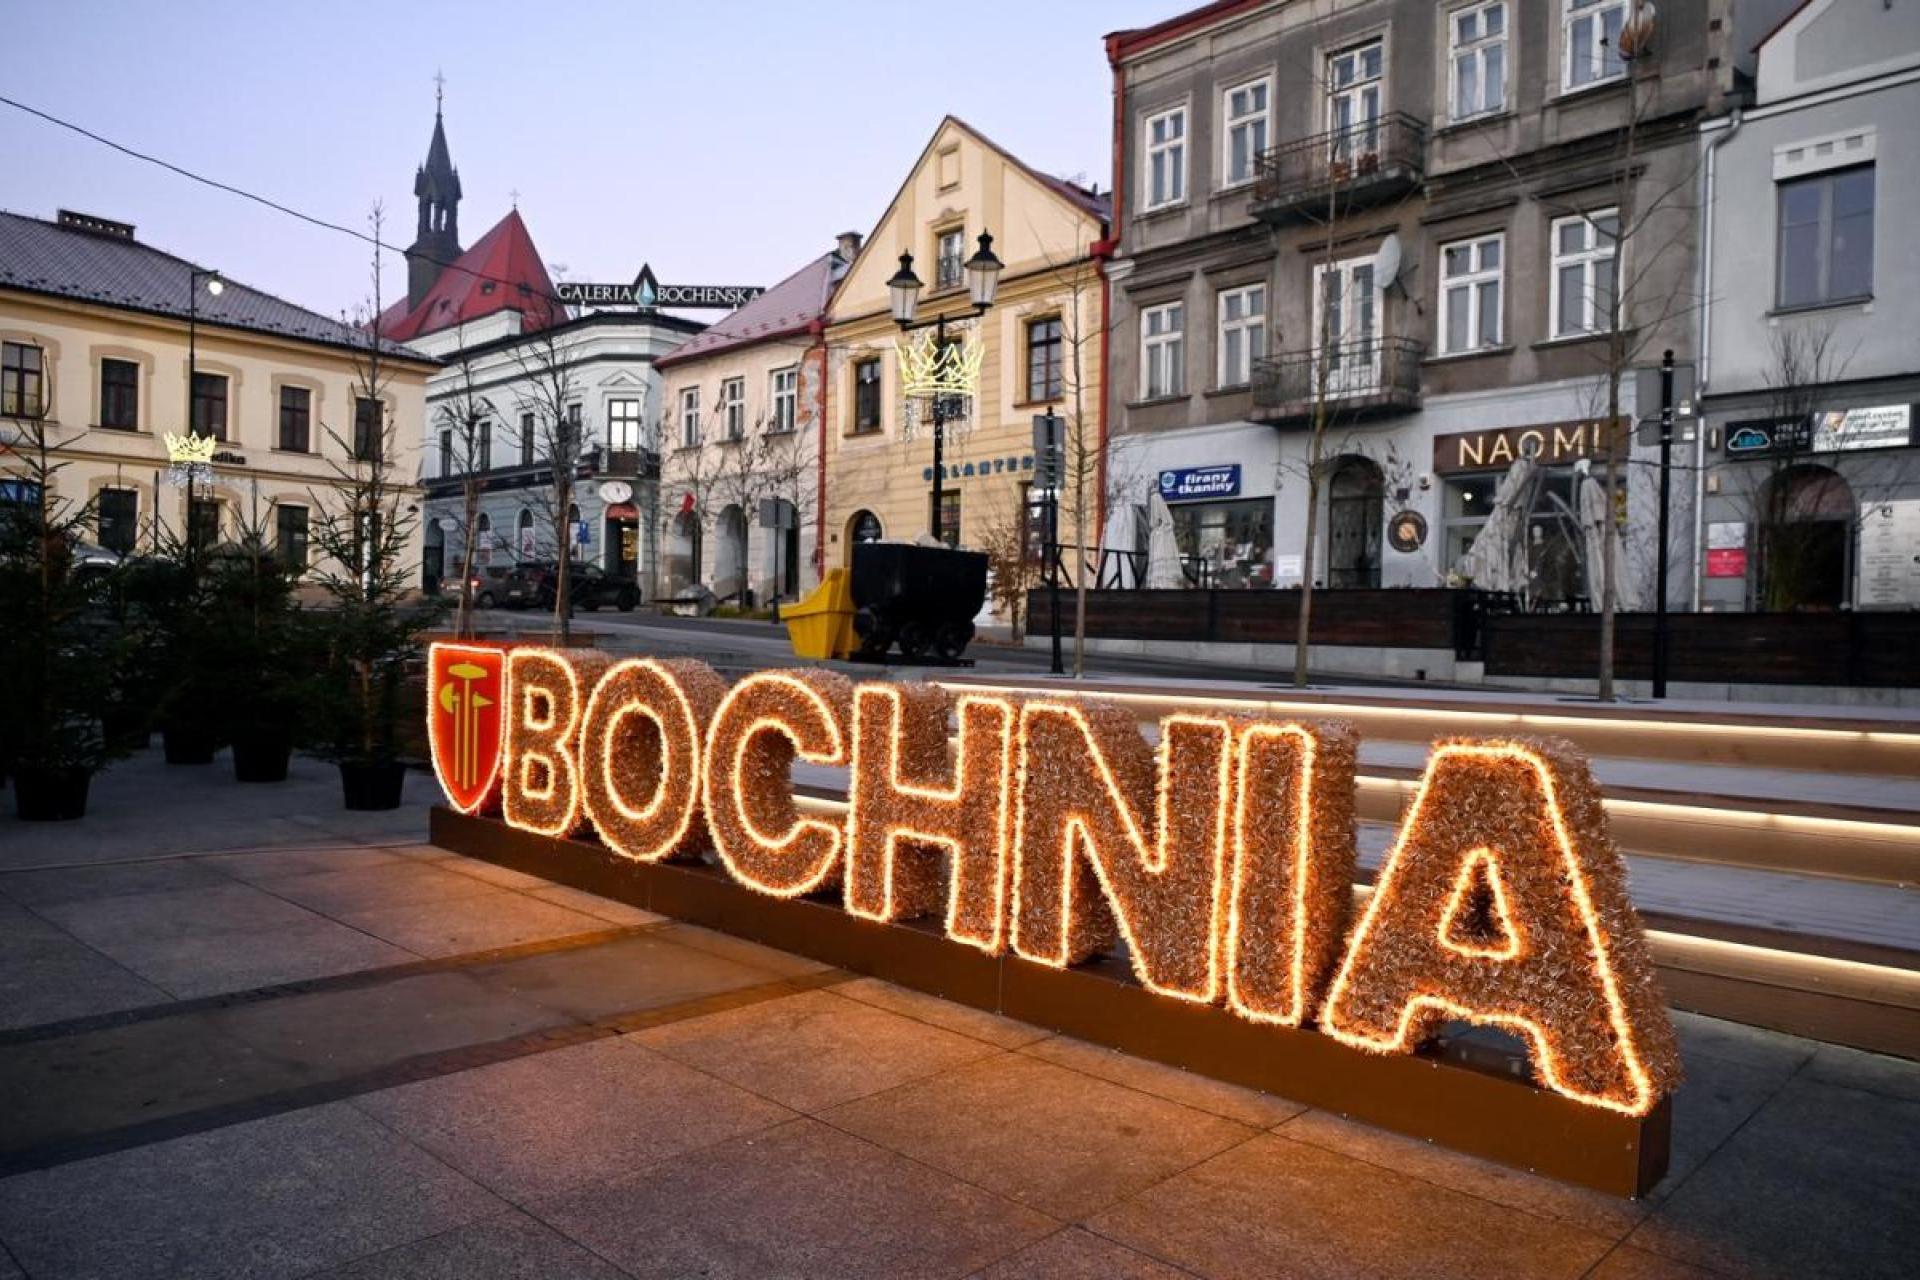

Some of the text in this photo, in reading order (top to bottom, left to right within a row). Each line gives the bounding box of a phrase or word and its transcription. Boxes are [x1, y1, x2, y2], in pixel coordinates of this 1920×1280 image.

[558, 285, 632, 301] GALERIA
[1458, 423, 1600, 467] NAOMI
[1185, 473, 1230, 484] firany
[1177, 482, 1235, 494] tkaniny
[502, 646, 1660, 1120] BOCHNIA
